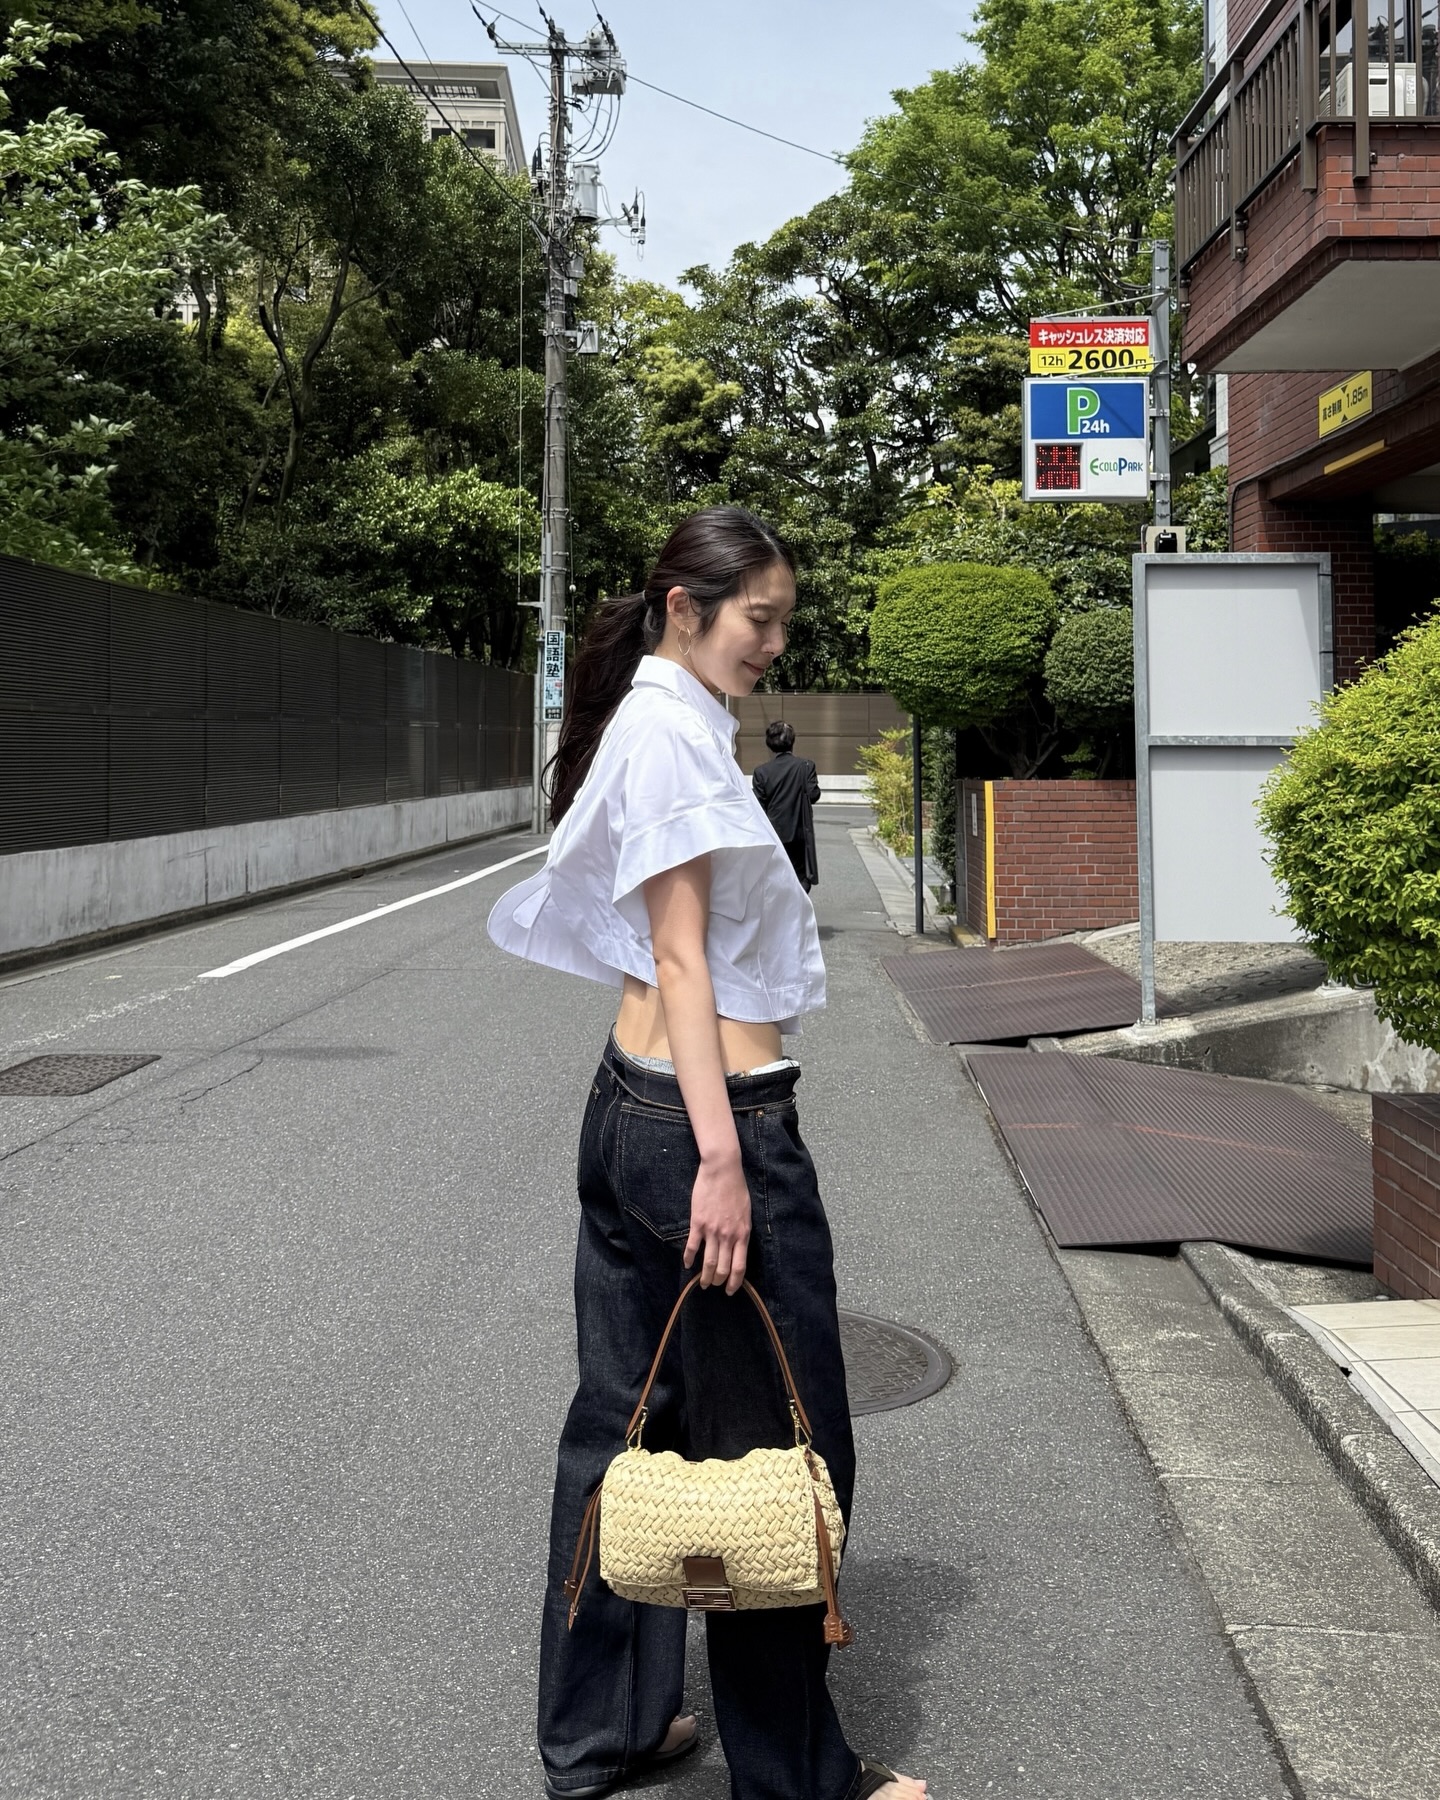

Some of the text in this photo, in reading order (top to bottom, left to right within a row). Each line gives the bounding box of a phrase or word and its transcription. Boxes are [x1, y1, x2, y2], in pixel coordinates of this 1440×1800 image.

[1038, 327, 1146, 345] キャッシュレス決済対応
[1041, 355, 1063, 366] 12h
[1346, 386, 1369, 408] 1.85m
[1067, 387, 1100, 435] P
[1082, 419, 1110, 434] 24h
[546, 632, 560, 678] 国語塾
